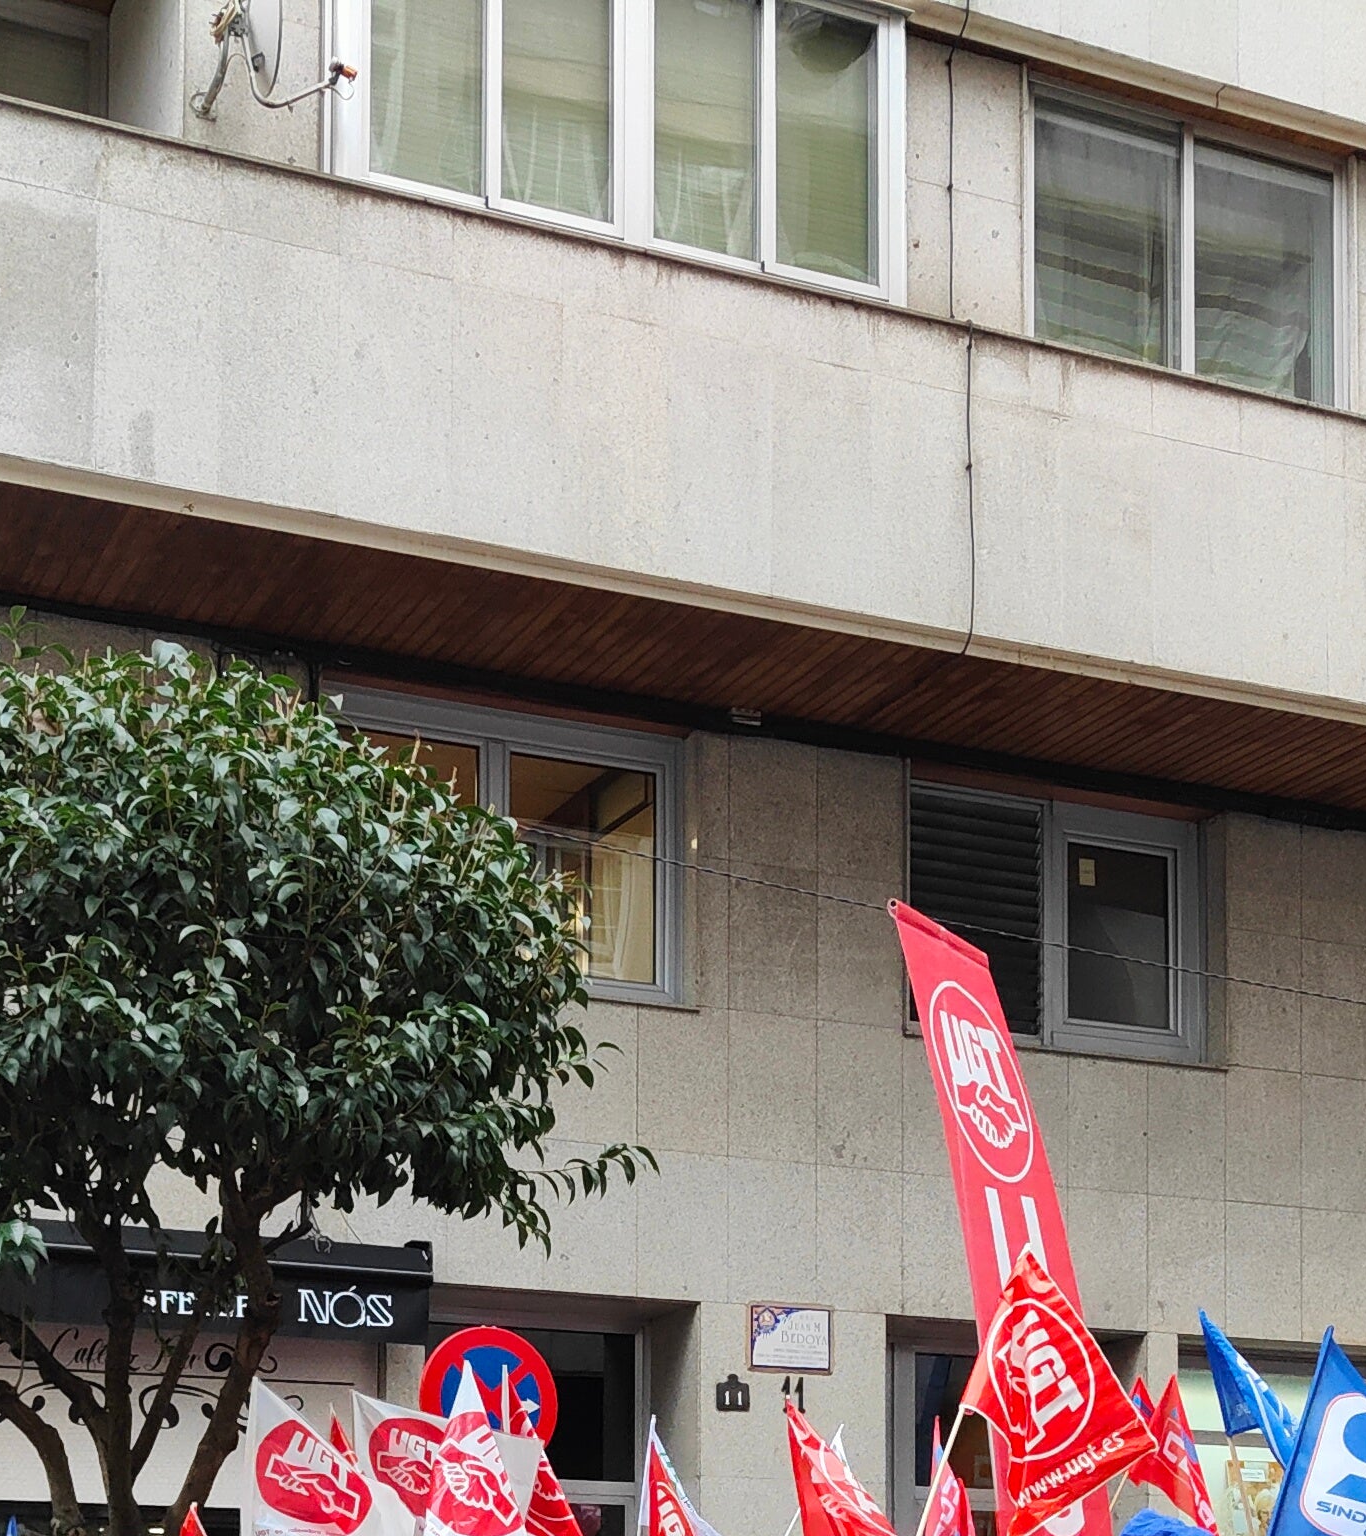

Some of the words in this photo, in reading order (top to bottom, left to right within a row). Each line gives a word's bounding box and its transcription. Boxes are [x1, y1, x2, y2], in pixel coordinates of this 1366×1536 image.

[940, 1010, 1012, 1100] UGT
[298, 1285, 394, 1327] NÓS
[781, 1330, 828, 1345] BEDOYA
[724, 1391, 742, 1405] 11
[1011, 1310, 1085, 1452] UGT
[283, 1431, 356, 1490] UGT
[1016, 1431, 1125, 1508] www.ugt.es
